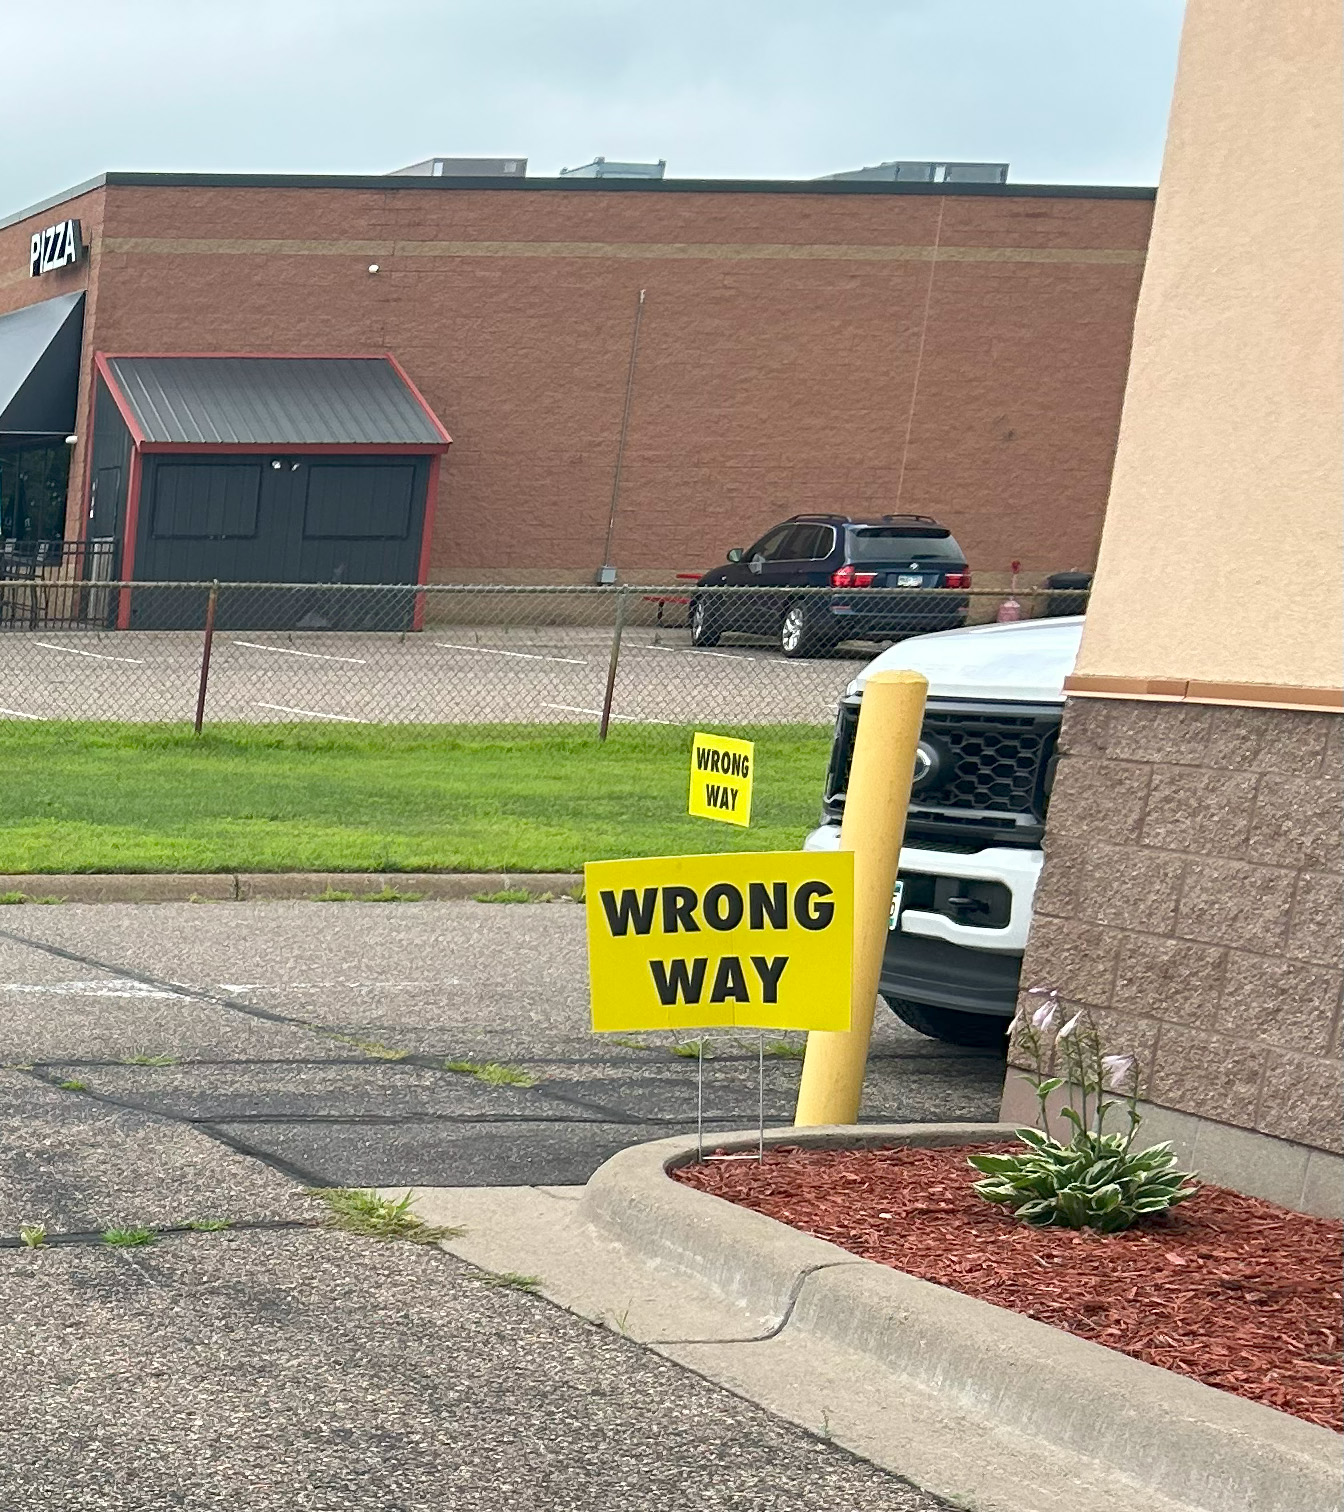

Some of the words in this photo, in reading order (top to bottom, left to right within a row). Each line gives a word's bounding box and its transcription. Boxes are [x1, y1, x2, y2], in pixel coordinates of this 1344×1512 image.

[30, 219, 77, 277] PIZZA
[697, 747, 749, 778] WRONG
[706, 784, 738, 811] WAY
[599, 880, 835, 937] WRONG
[649, 956, 789, 1006] WAY
